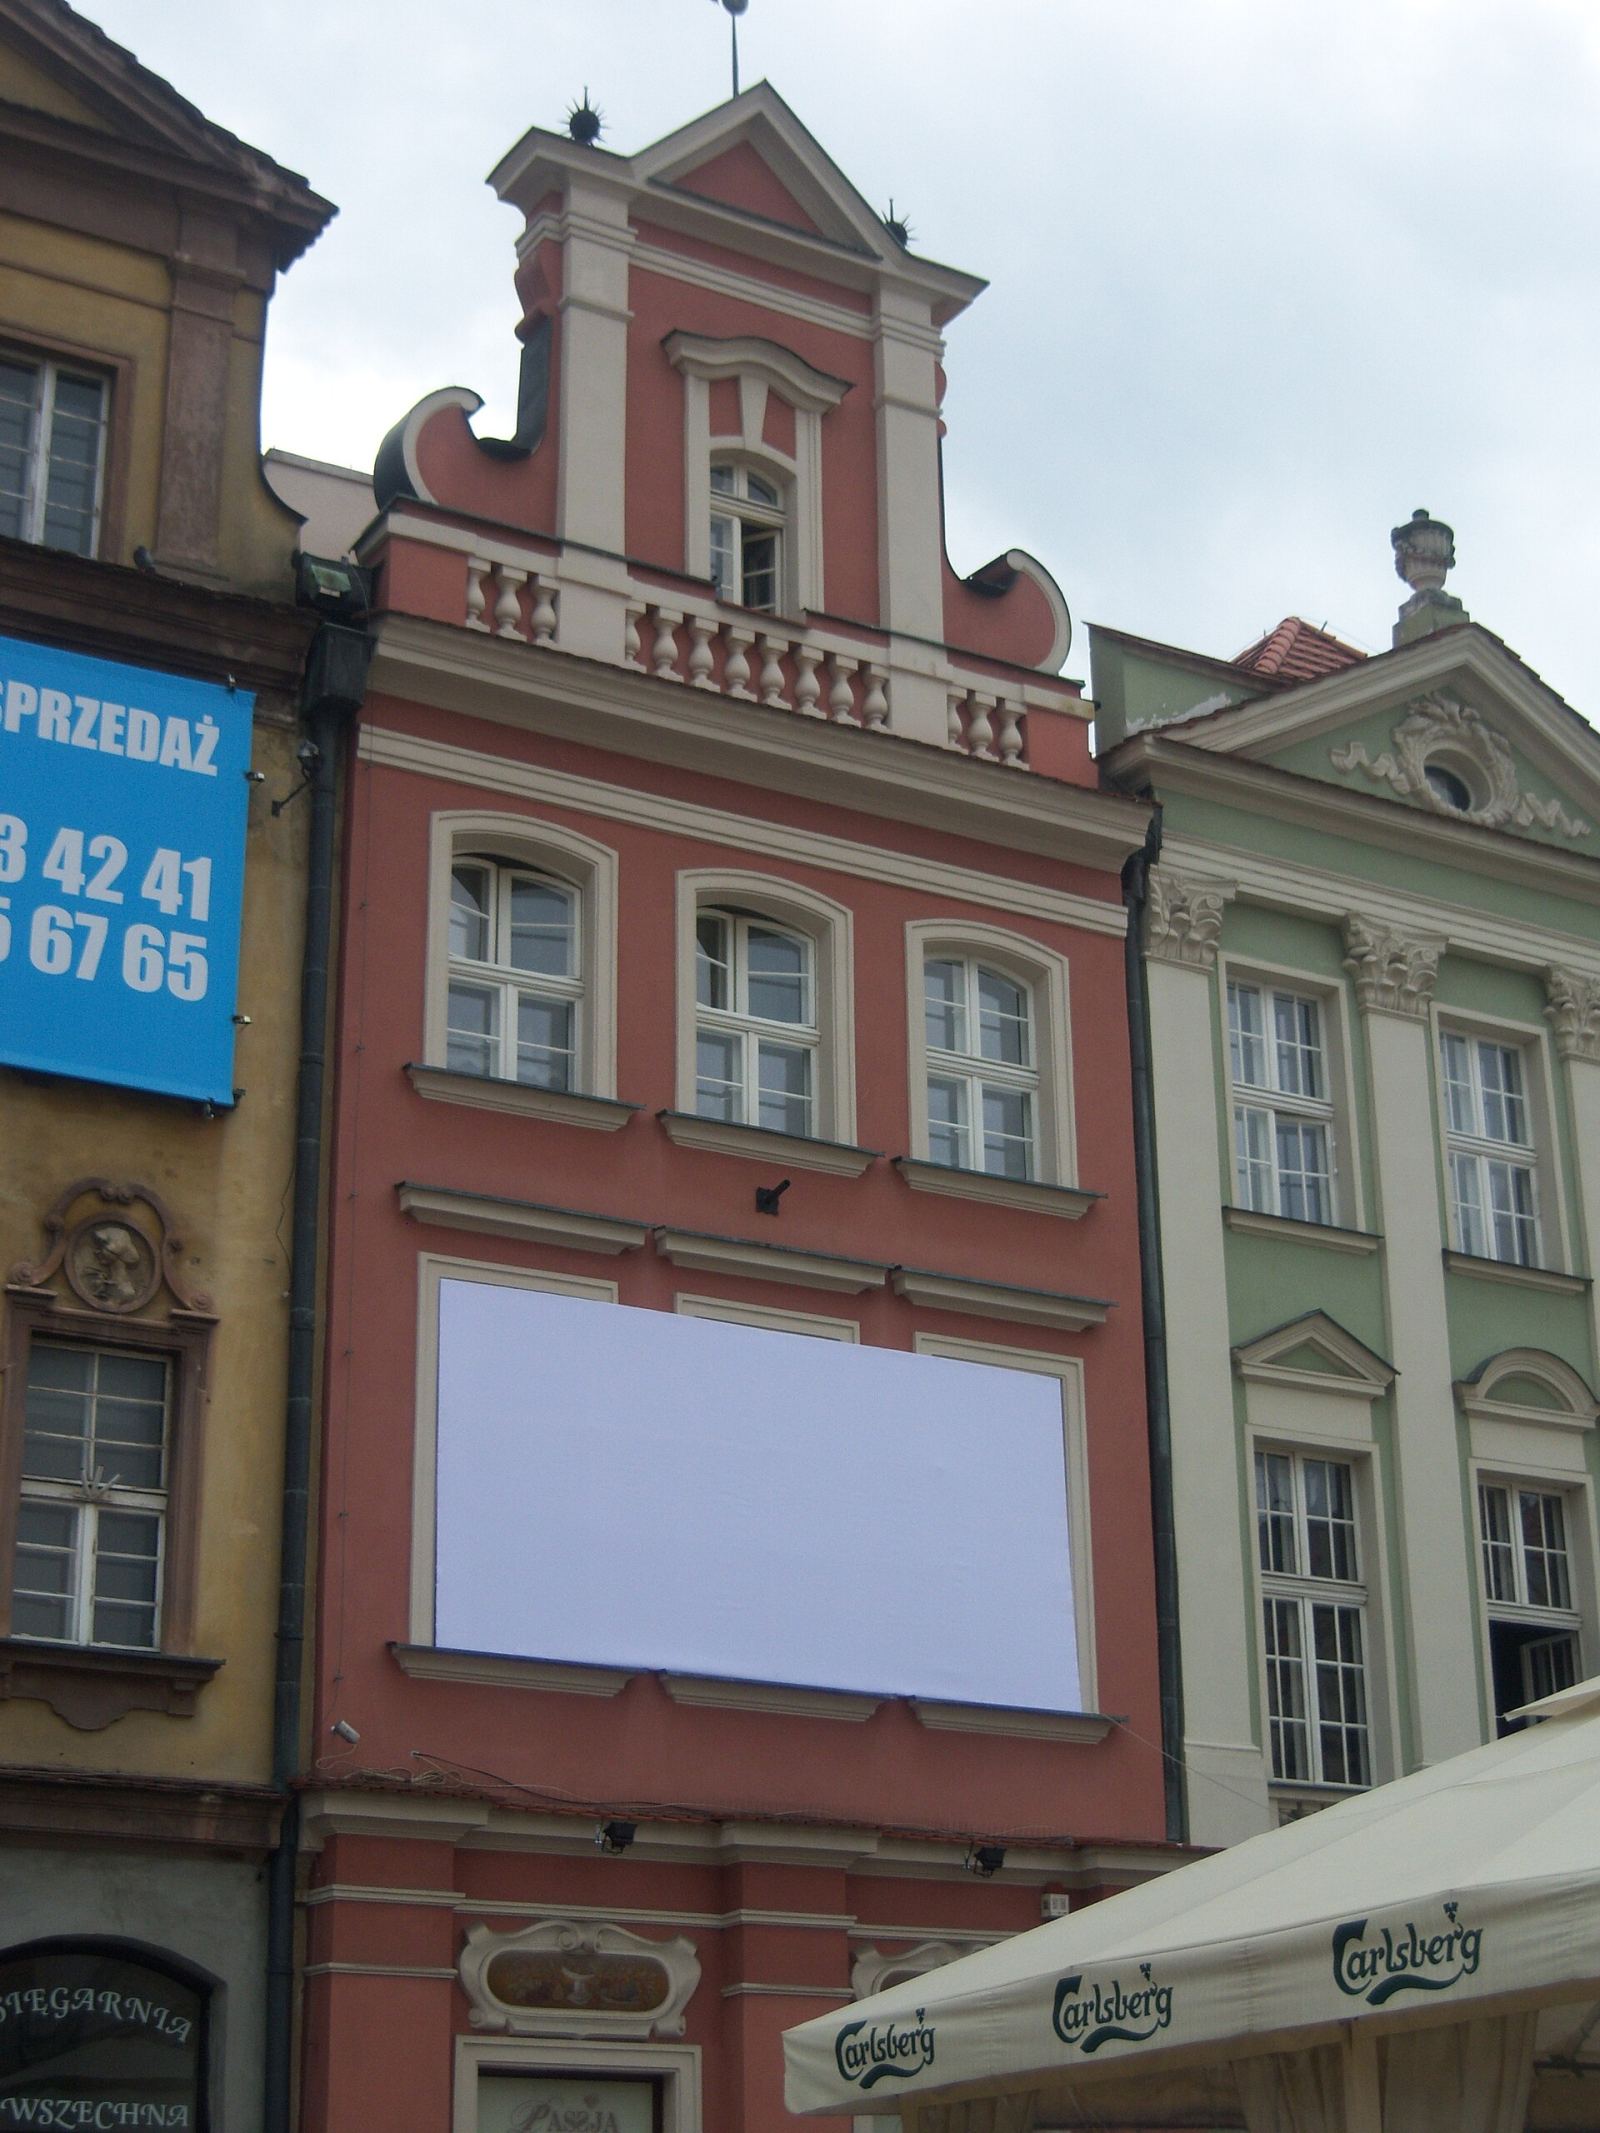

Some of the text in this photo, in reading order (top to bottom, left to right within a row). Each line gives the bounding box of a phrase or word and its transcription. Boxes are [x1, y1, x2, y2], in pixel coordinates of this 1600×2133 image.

[0, 680, 220, 776] PRZEDAŻ
[42, 827, 128, 904] 42
[140, 848, 212, 922] 41
[29, 905, 109, 981] 67
[122, 923, 208, 1002] 65
[1332, 1919, 1483, 2006] Carlsberg
[835, 2020, 936, 2090] Carlsberg
[1052, 1975, 1174, 2054] Carlsberg
[0, 2097, 190, 2130] WSZECHNA
